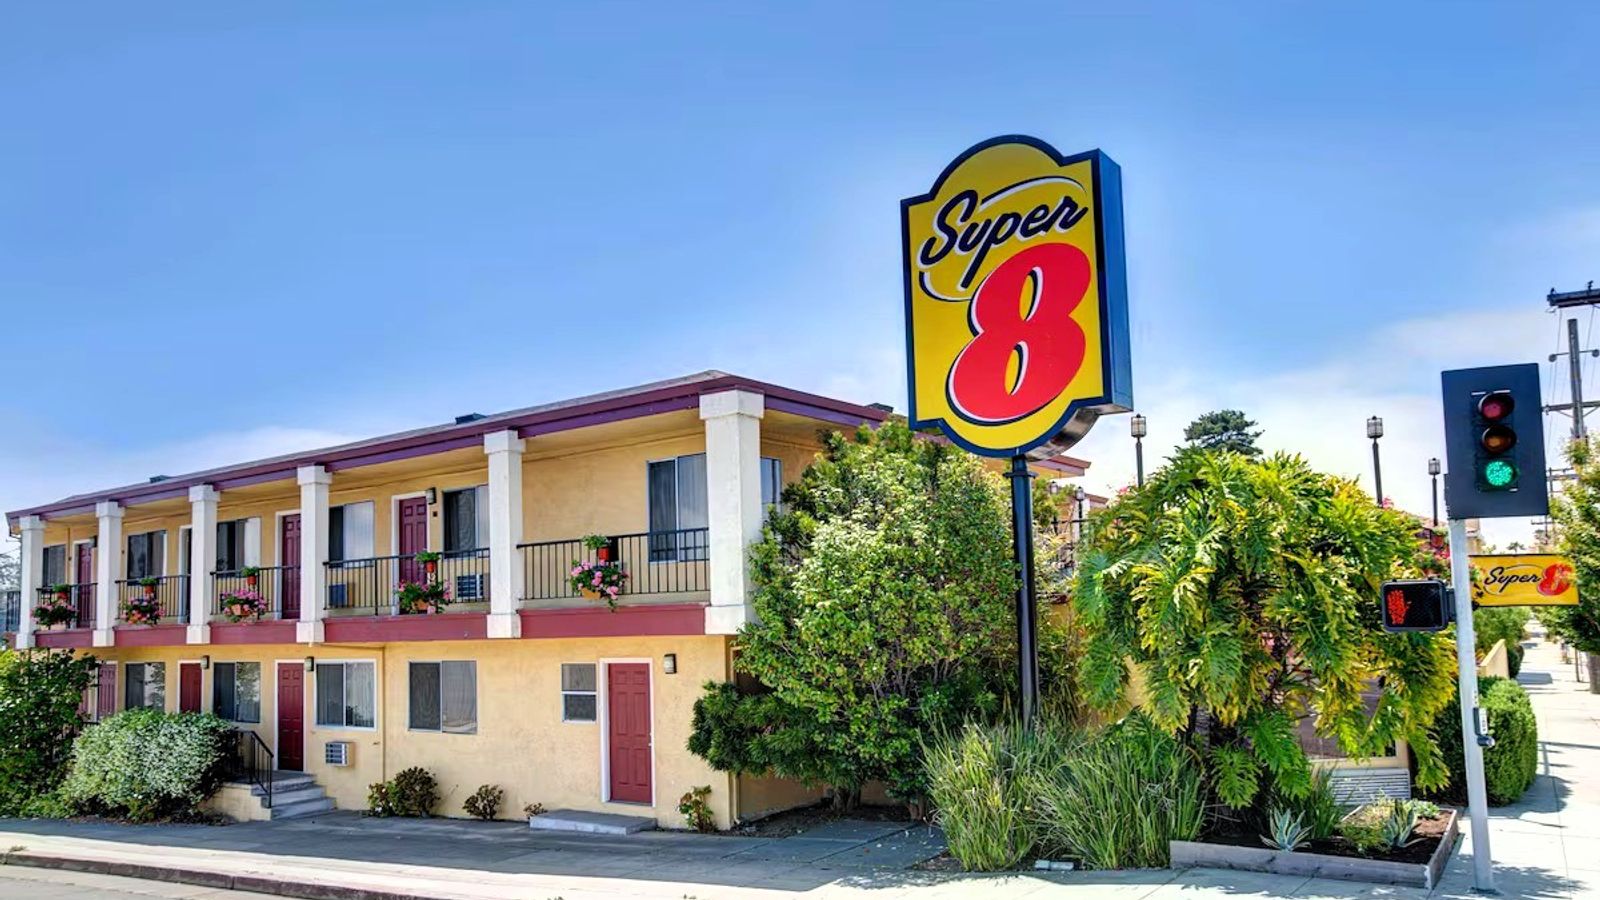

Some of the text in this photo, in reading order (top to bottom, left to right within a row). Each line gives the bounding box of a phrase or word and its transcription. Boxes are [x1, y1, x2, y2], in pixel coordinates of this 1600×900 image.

[918, 189, 1088, 291] Super
[946, 243, 1091, 426] 8
[1484, 566, 1541, 593] Super
